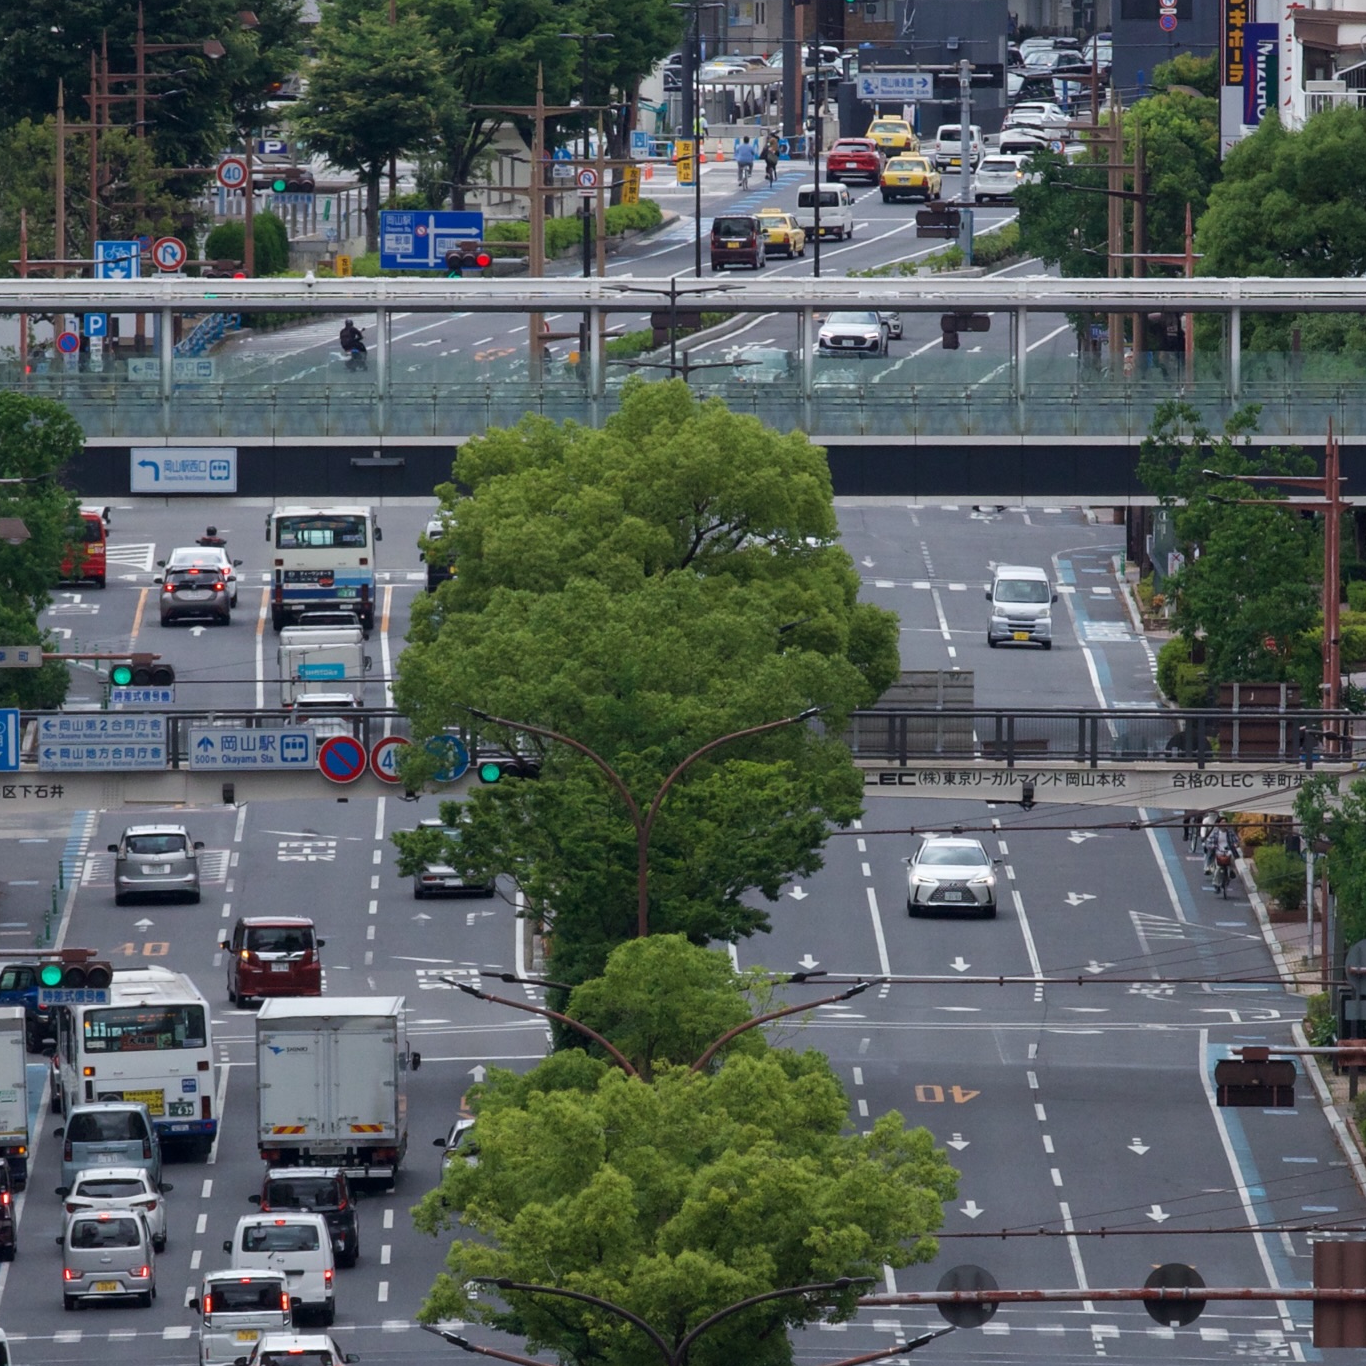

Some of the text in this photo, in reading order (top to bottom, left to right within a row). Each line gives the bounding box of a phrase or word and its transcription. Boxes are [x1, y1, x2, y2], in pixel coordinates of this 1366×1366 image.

[264, 141, 282, 153] P
[224, 167, 241, 181] 40
[90, 316, 102, 334] P
[113, 690, 170, 702] 時差式信号機
[59, 719, 161, 732] 岡山第2合同庁舎
[221, 735, 276, 751] 岡山駅
[60, 747, 161, 760] 岡山地方合同庁舎
[195, 755, 217, 763] 500m
[221, 754, 257, 765] Okayama
[1065, 772, 1126, 788] 岡山本校
[1172, 773, 1254, 788] 合格のLEC
[111, 942, 169, 956] 40
[43, 990, 106, 1003] 時差式信号機
